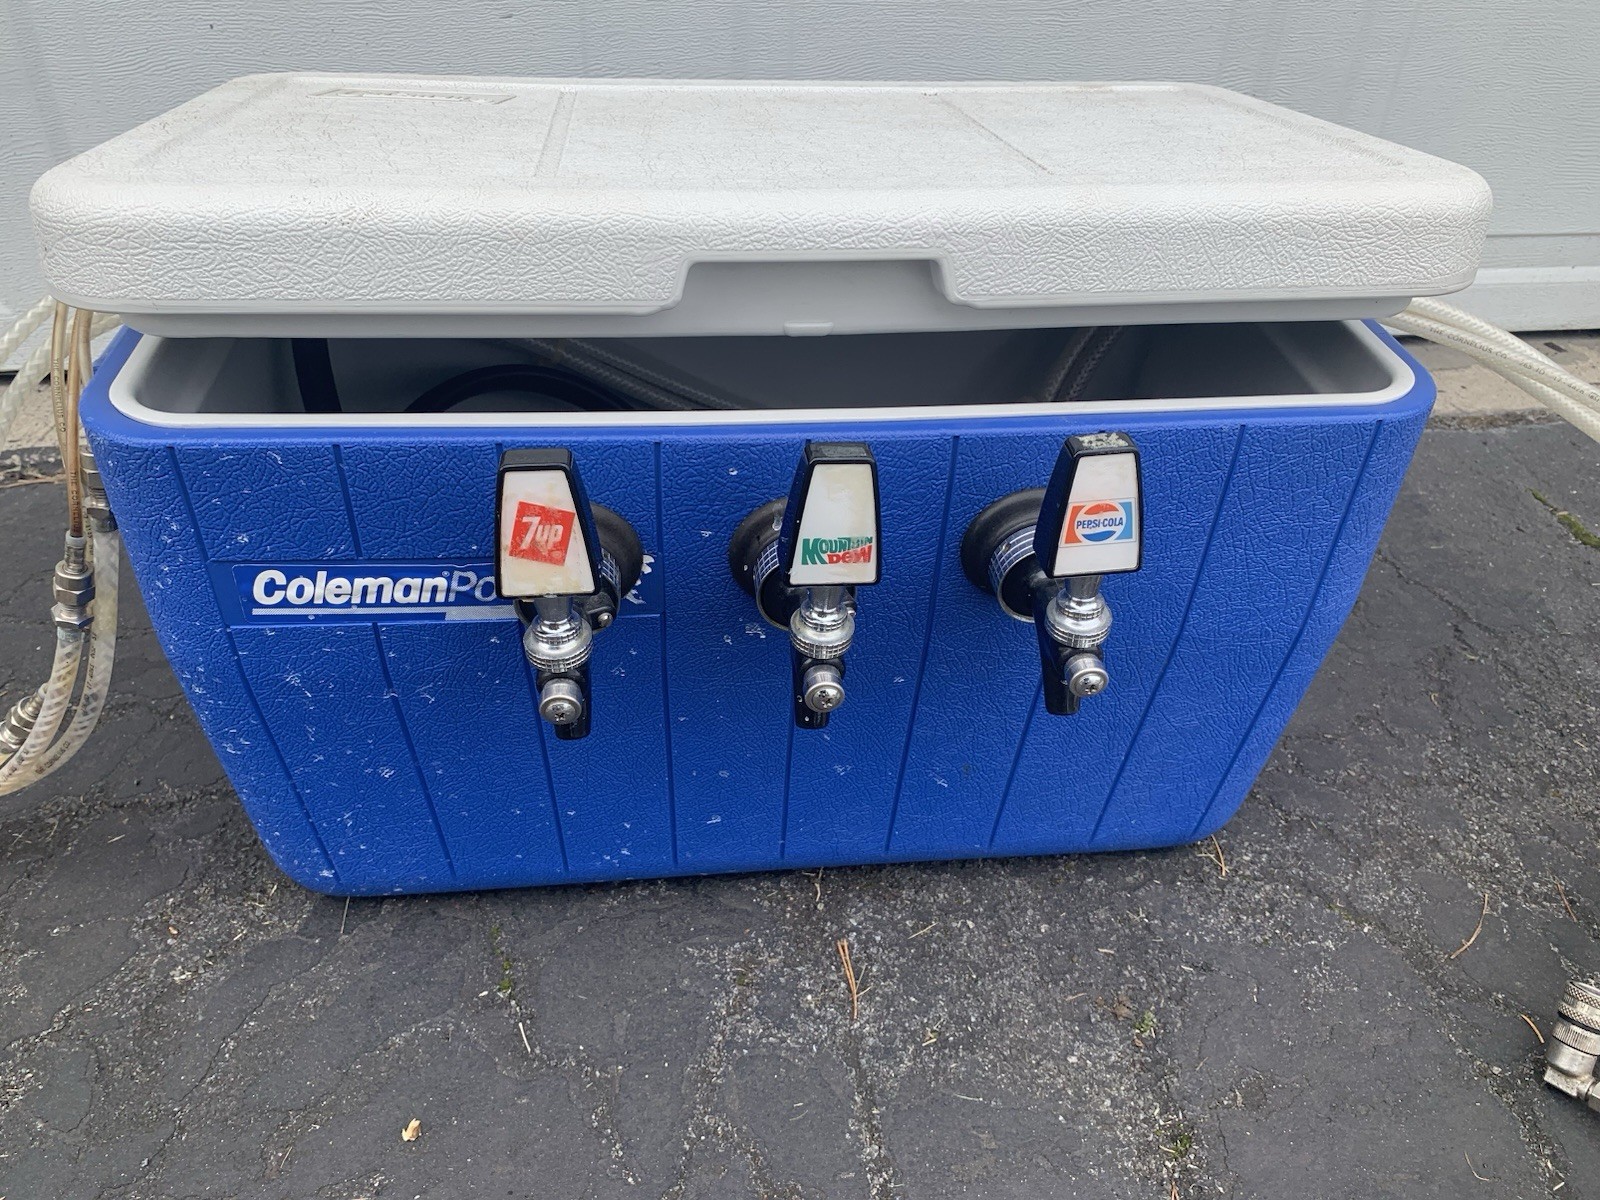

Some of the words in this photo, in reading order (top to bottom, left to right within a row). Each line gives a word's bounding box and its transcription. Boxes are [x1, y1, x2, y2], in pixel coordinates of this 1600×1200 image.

[1429, 327, 1444, 336] THE
[1447, 333, 1494, 354] CORNELIUS
[53, 375, 64, 419] CORNELIUS
[70, 471, 78, 486] THE
